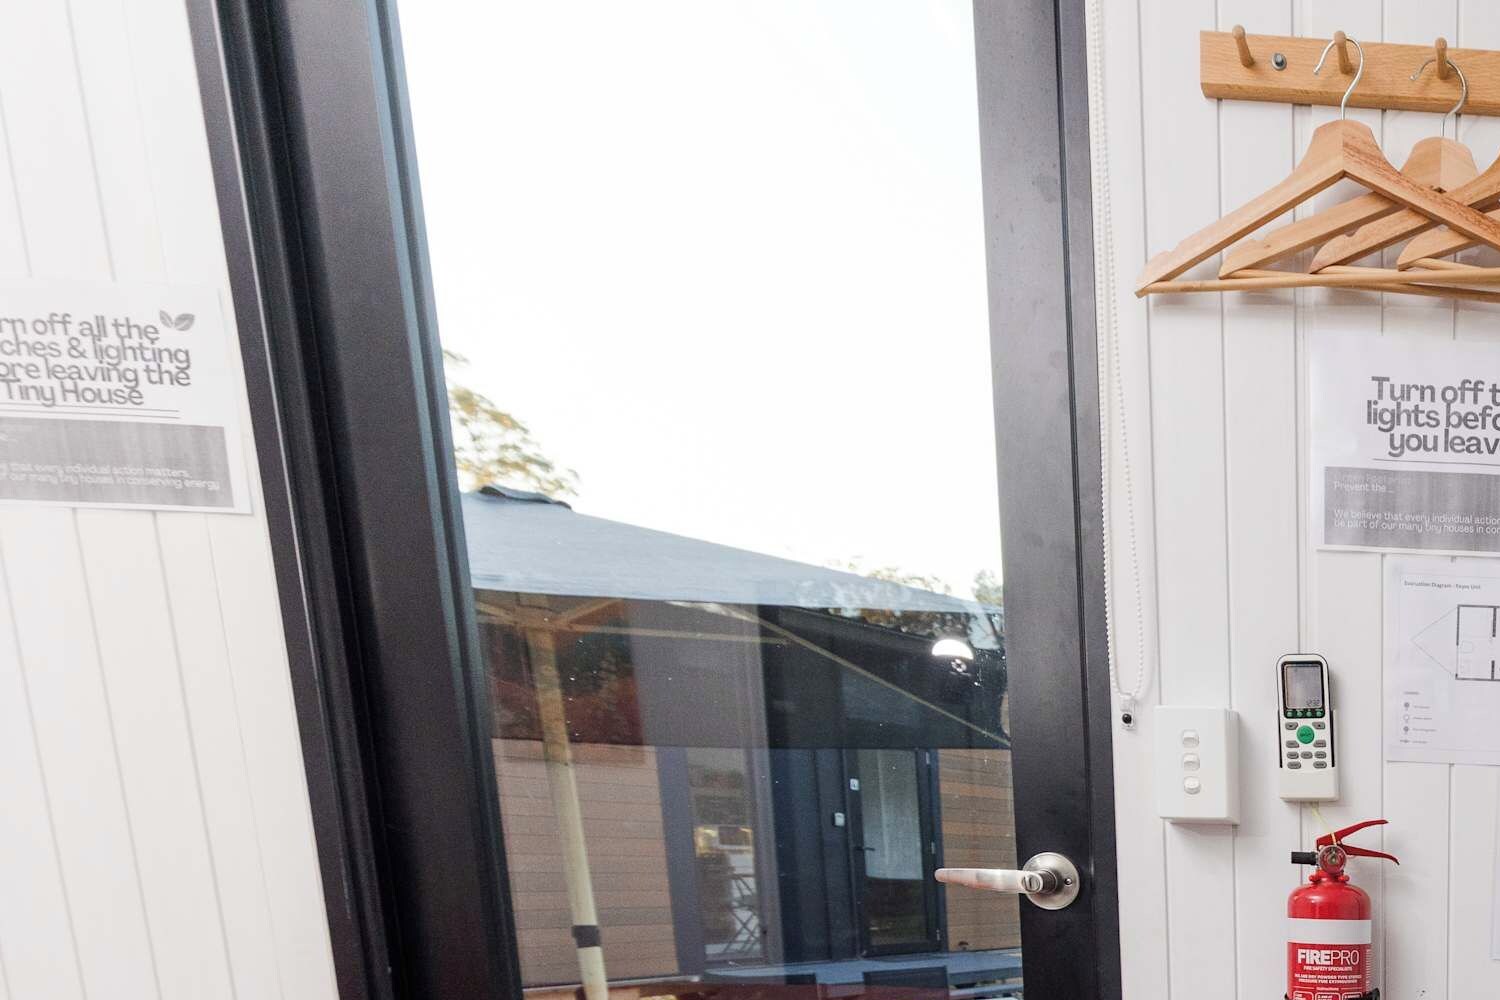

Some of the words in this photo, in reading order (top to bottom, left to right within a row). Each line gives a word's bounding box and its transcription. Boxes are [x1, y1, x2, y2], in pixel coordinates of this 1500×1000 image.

[32, 312, 72, 336] off
[79, 315, 108, 338] all
[112, 317, 160, 341] the
[0, 334, 62, 358] ches
[67, 336, 88, 359] &
[92, 334, 190, 371] lighting
[44, 357, 138, 389] leaving
[143, 363, 192, 387] the
[0, 377, 56, 407] Tiny
[60, 380, 144, 405] House
[1371, 376, 1436, 403] Turn
[1441, 379, 1485, 405] off
[1367, 400, 1440, 433] lights
[1388, 433, 1439, 458] you
[1297, 948, 1360, 966] FIREPRO
